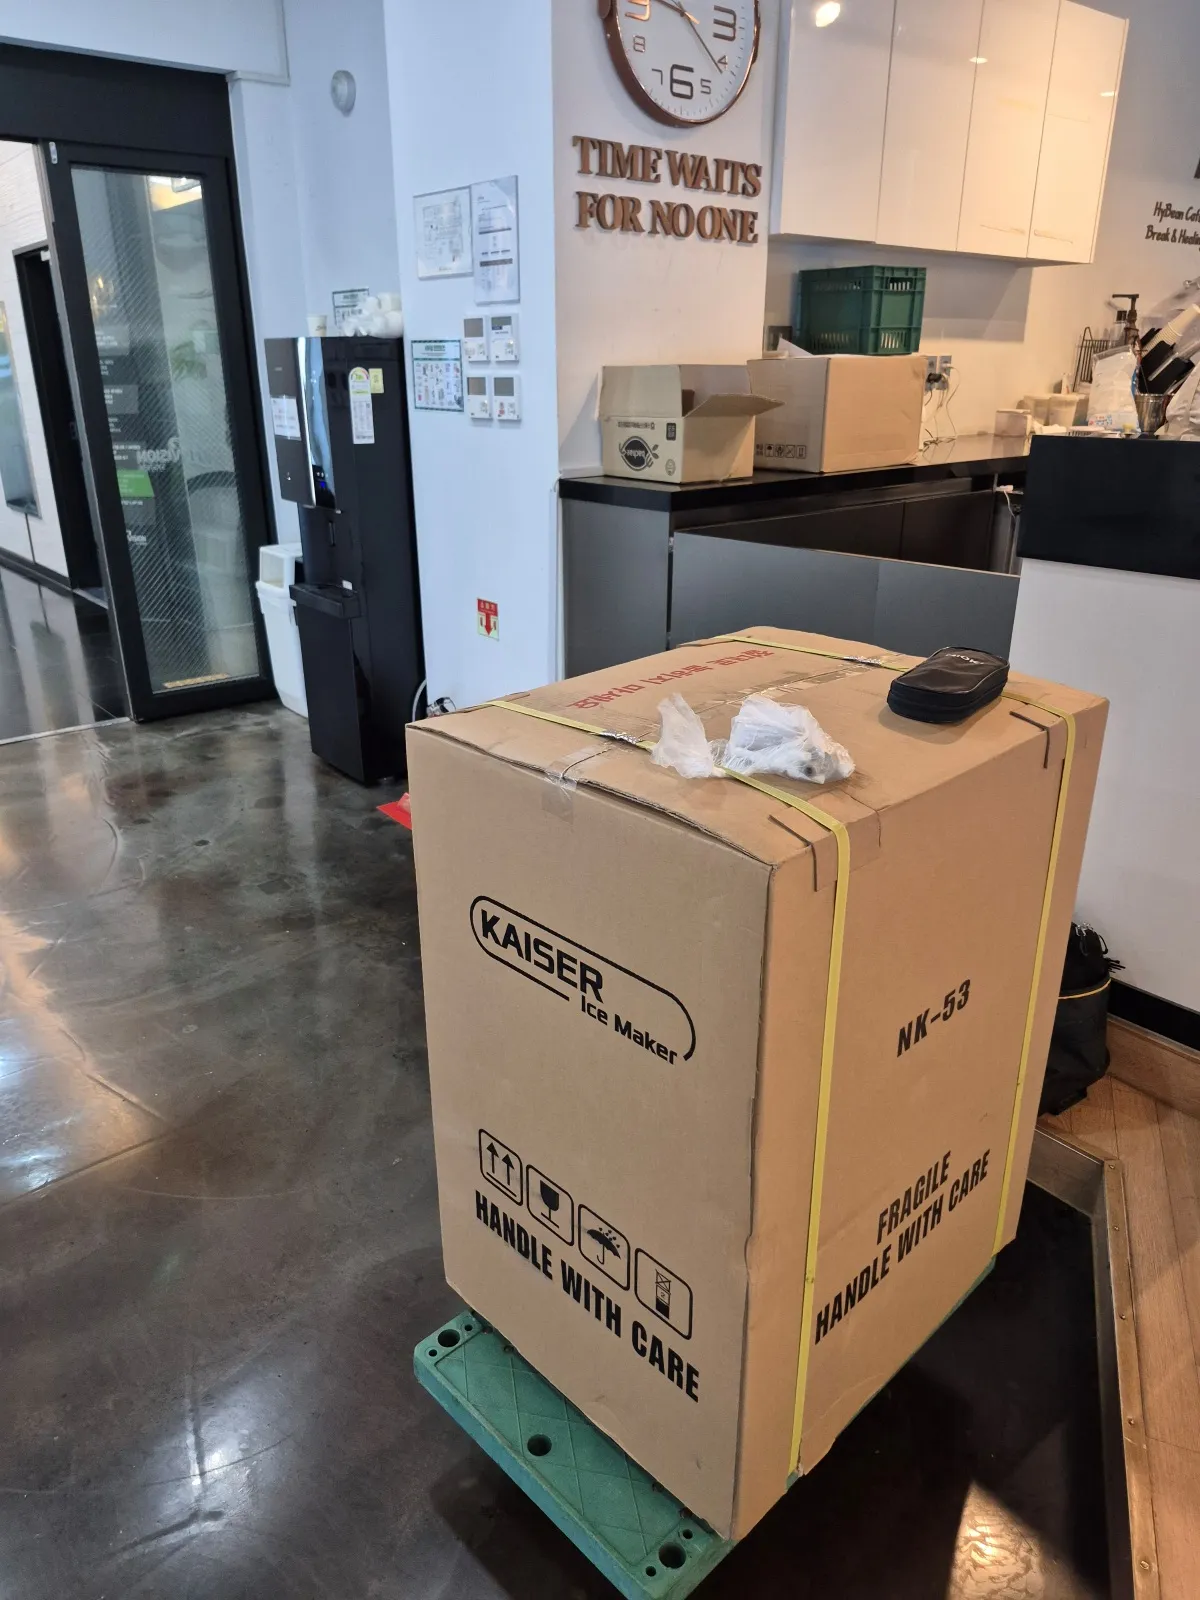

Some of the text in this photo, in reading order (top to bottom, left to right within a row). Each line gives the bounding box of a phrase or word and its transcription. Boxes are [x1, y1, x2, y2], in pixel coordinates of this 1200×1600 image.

[633, 35, 646, 53] 8
[713, 5, 737, 42] 3
[651, 68, 664, 86] 7
[669, 63, 695, 100] 6
[700, 78, 712, 95] 5
[572, 135, 763, 198] TIME WAITS
[575, 190, 760, 244] FOR NO ONE
[1145, 224, 1170, 242] Break
[1170, 228, 1178, 243] &
[565, 683, 645, 709] 마세요
[480, 908, 604, 1004] KAISER
[581, 994, 678, 1066] Ice Maker
[896, 978, 971, 1058] NK-53
[876, 1150, 951, 1246] FRAGILE
[814, 1149, 991, 1345] HANDLE WITH CARE
[475, 1189, 700, 1404] HANDLE WITH CARE
